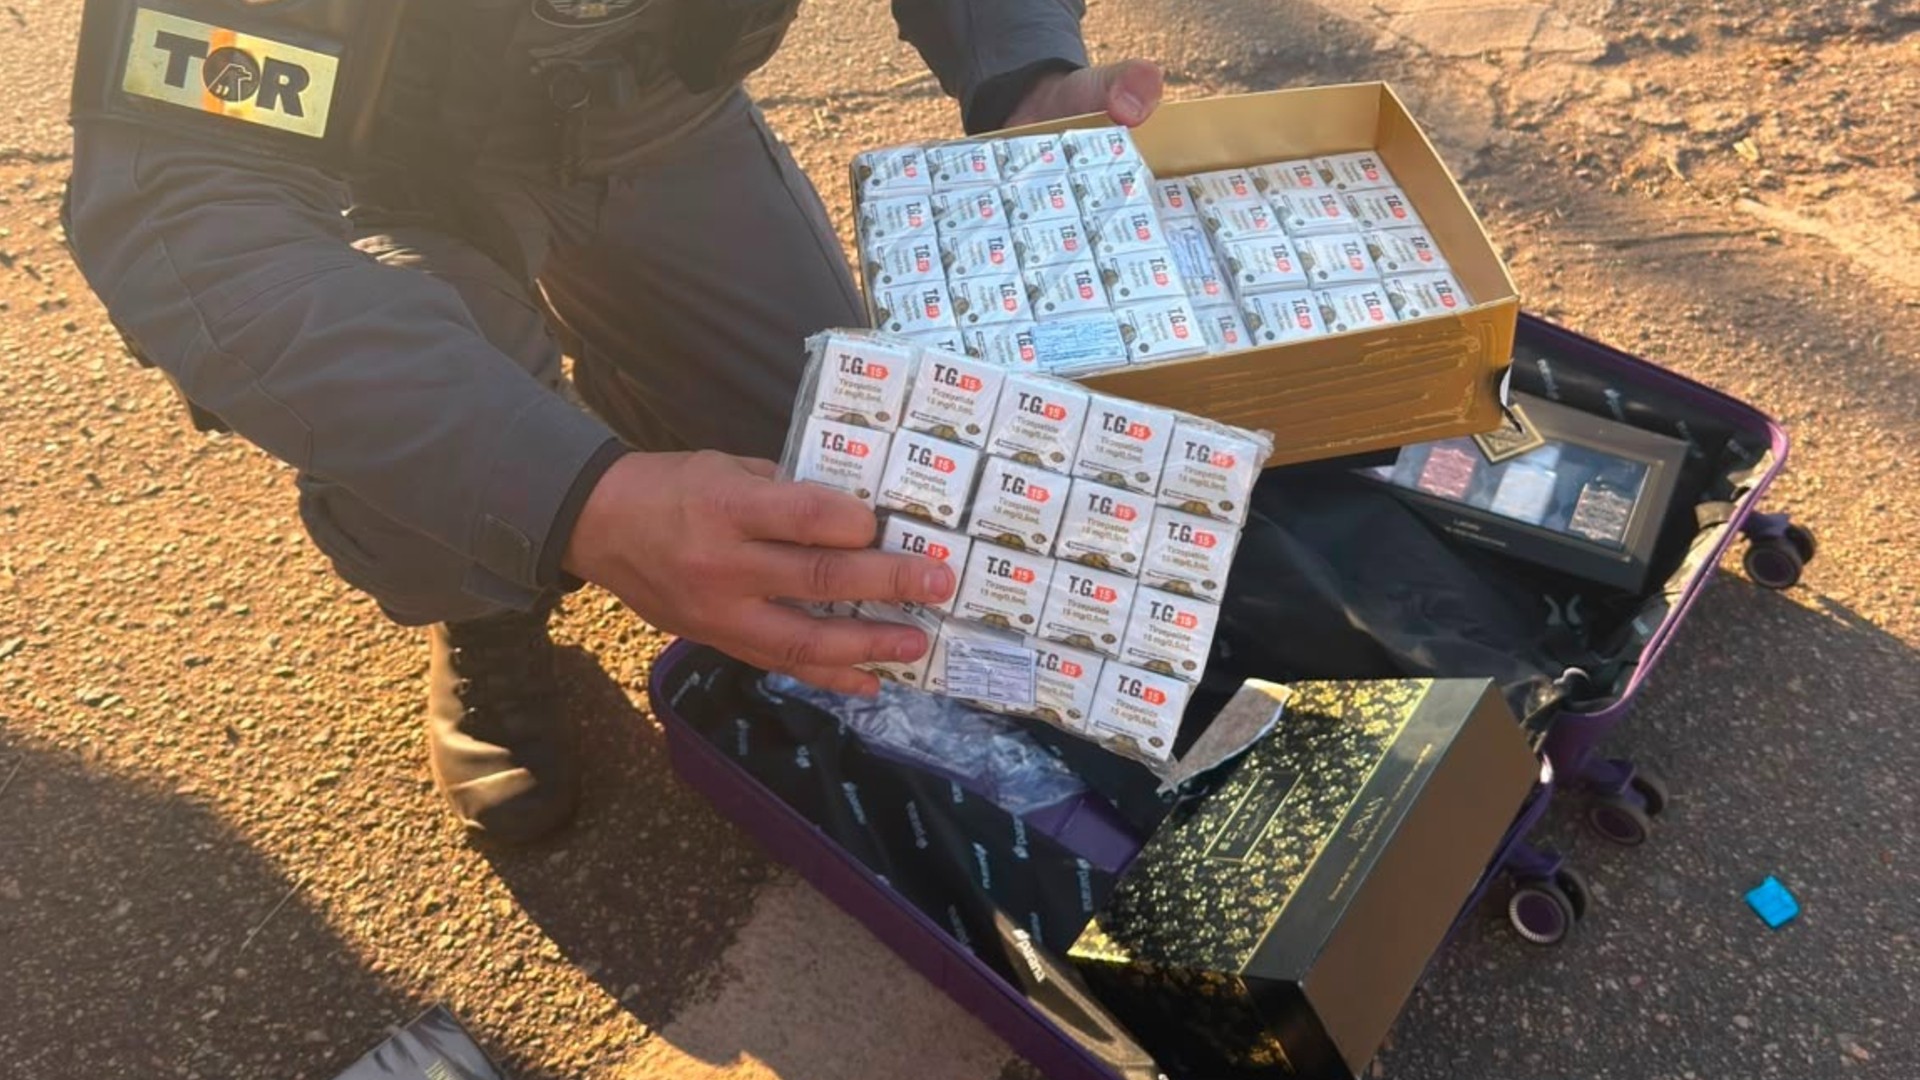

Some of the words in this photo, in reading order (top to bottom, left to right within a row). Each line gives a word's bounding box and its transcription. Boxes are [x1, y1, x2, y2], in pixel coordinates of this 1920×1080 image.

[154, 29, 311, 118] TOR
[840, 354, 866, 376] T.G.
[934, 364, 959, 387] T.G.
[1018, 392, 1044, 416] T.G.
[1102, 412, 1128, 435] T.G.
[821, 431, 847, 453] T.G.
[1185, 441, 1212, 464] T.G.
[907, 444, 933, 468] T.G.
[1000, 473, 1026, 497] T.G.
[1088, 494, 1114, 516] T.G.
[1168, 522, 1194, 544] T.G.
[987, 556, 1012, 579] T.G.
[1069, 575, 1094, 598] T.G.
[1150, 601, 1176, 624] T.G.
[1117, 675, 1143, 699] T.G.
